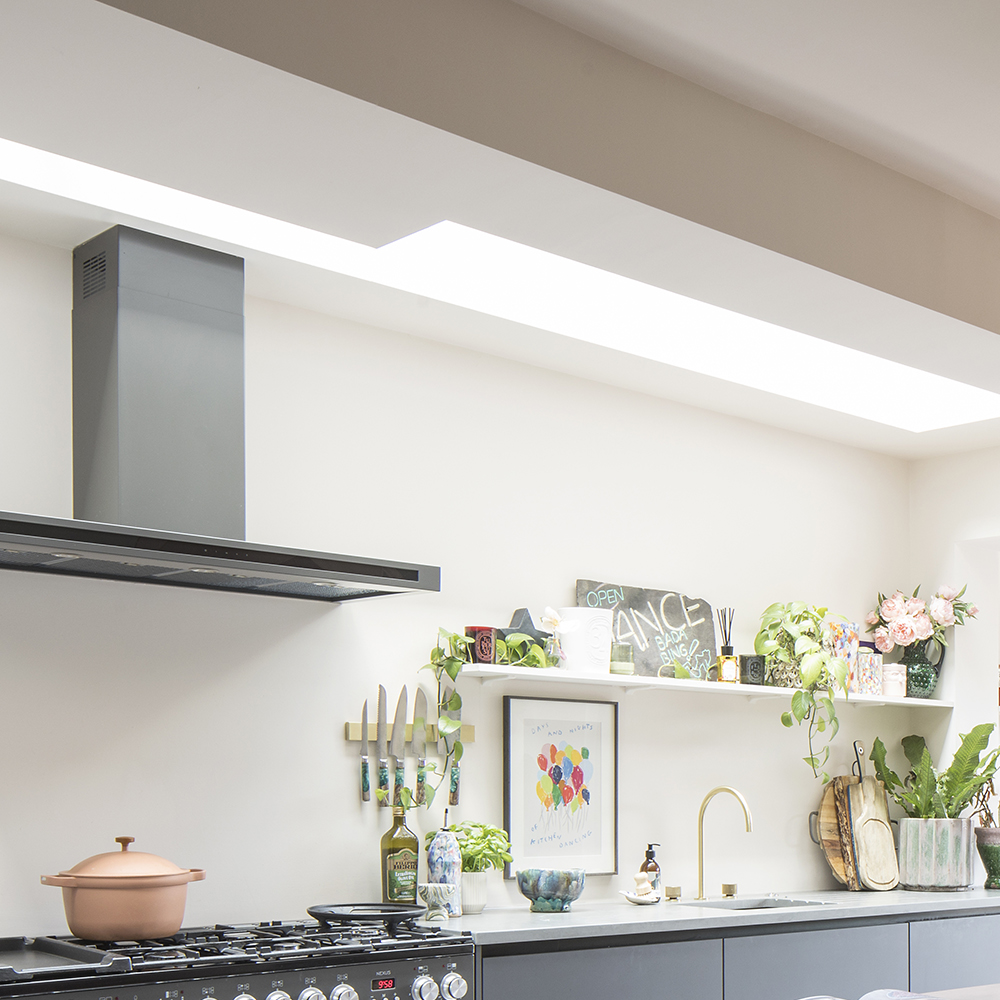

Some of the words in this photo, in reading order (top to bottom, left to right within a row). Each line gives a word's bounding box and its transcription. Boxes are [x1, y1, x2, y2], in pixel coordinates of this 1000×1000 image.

[586, 587, 624, 607] OPEN
[612, 592, 705, 651] ANCE
[654, 630, 688, 651] BADA
[530, 832, 562, 845] KITCHEN
[559, 830, 593, 848] DANCING
